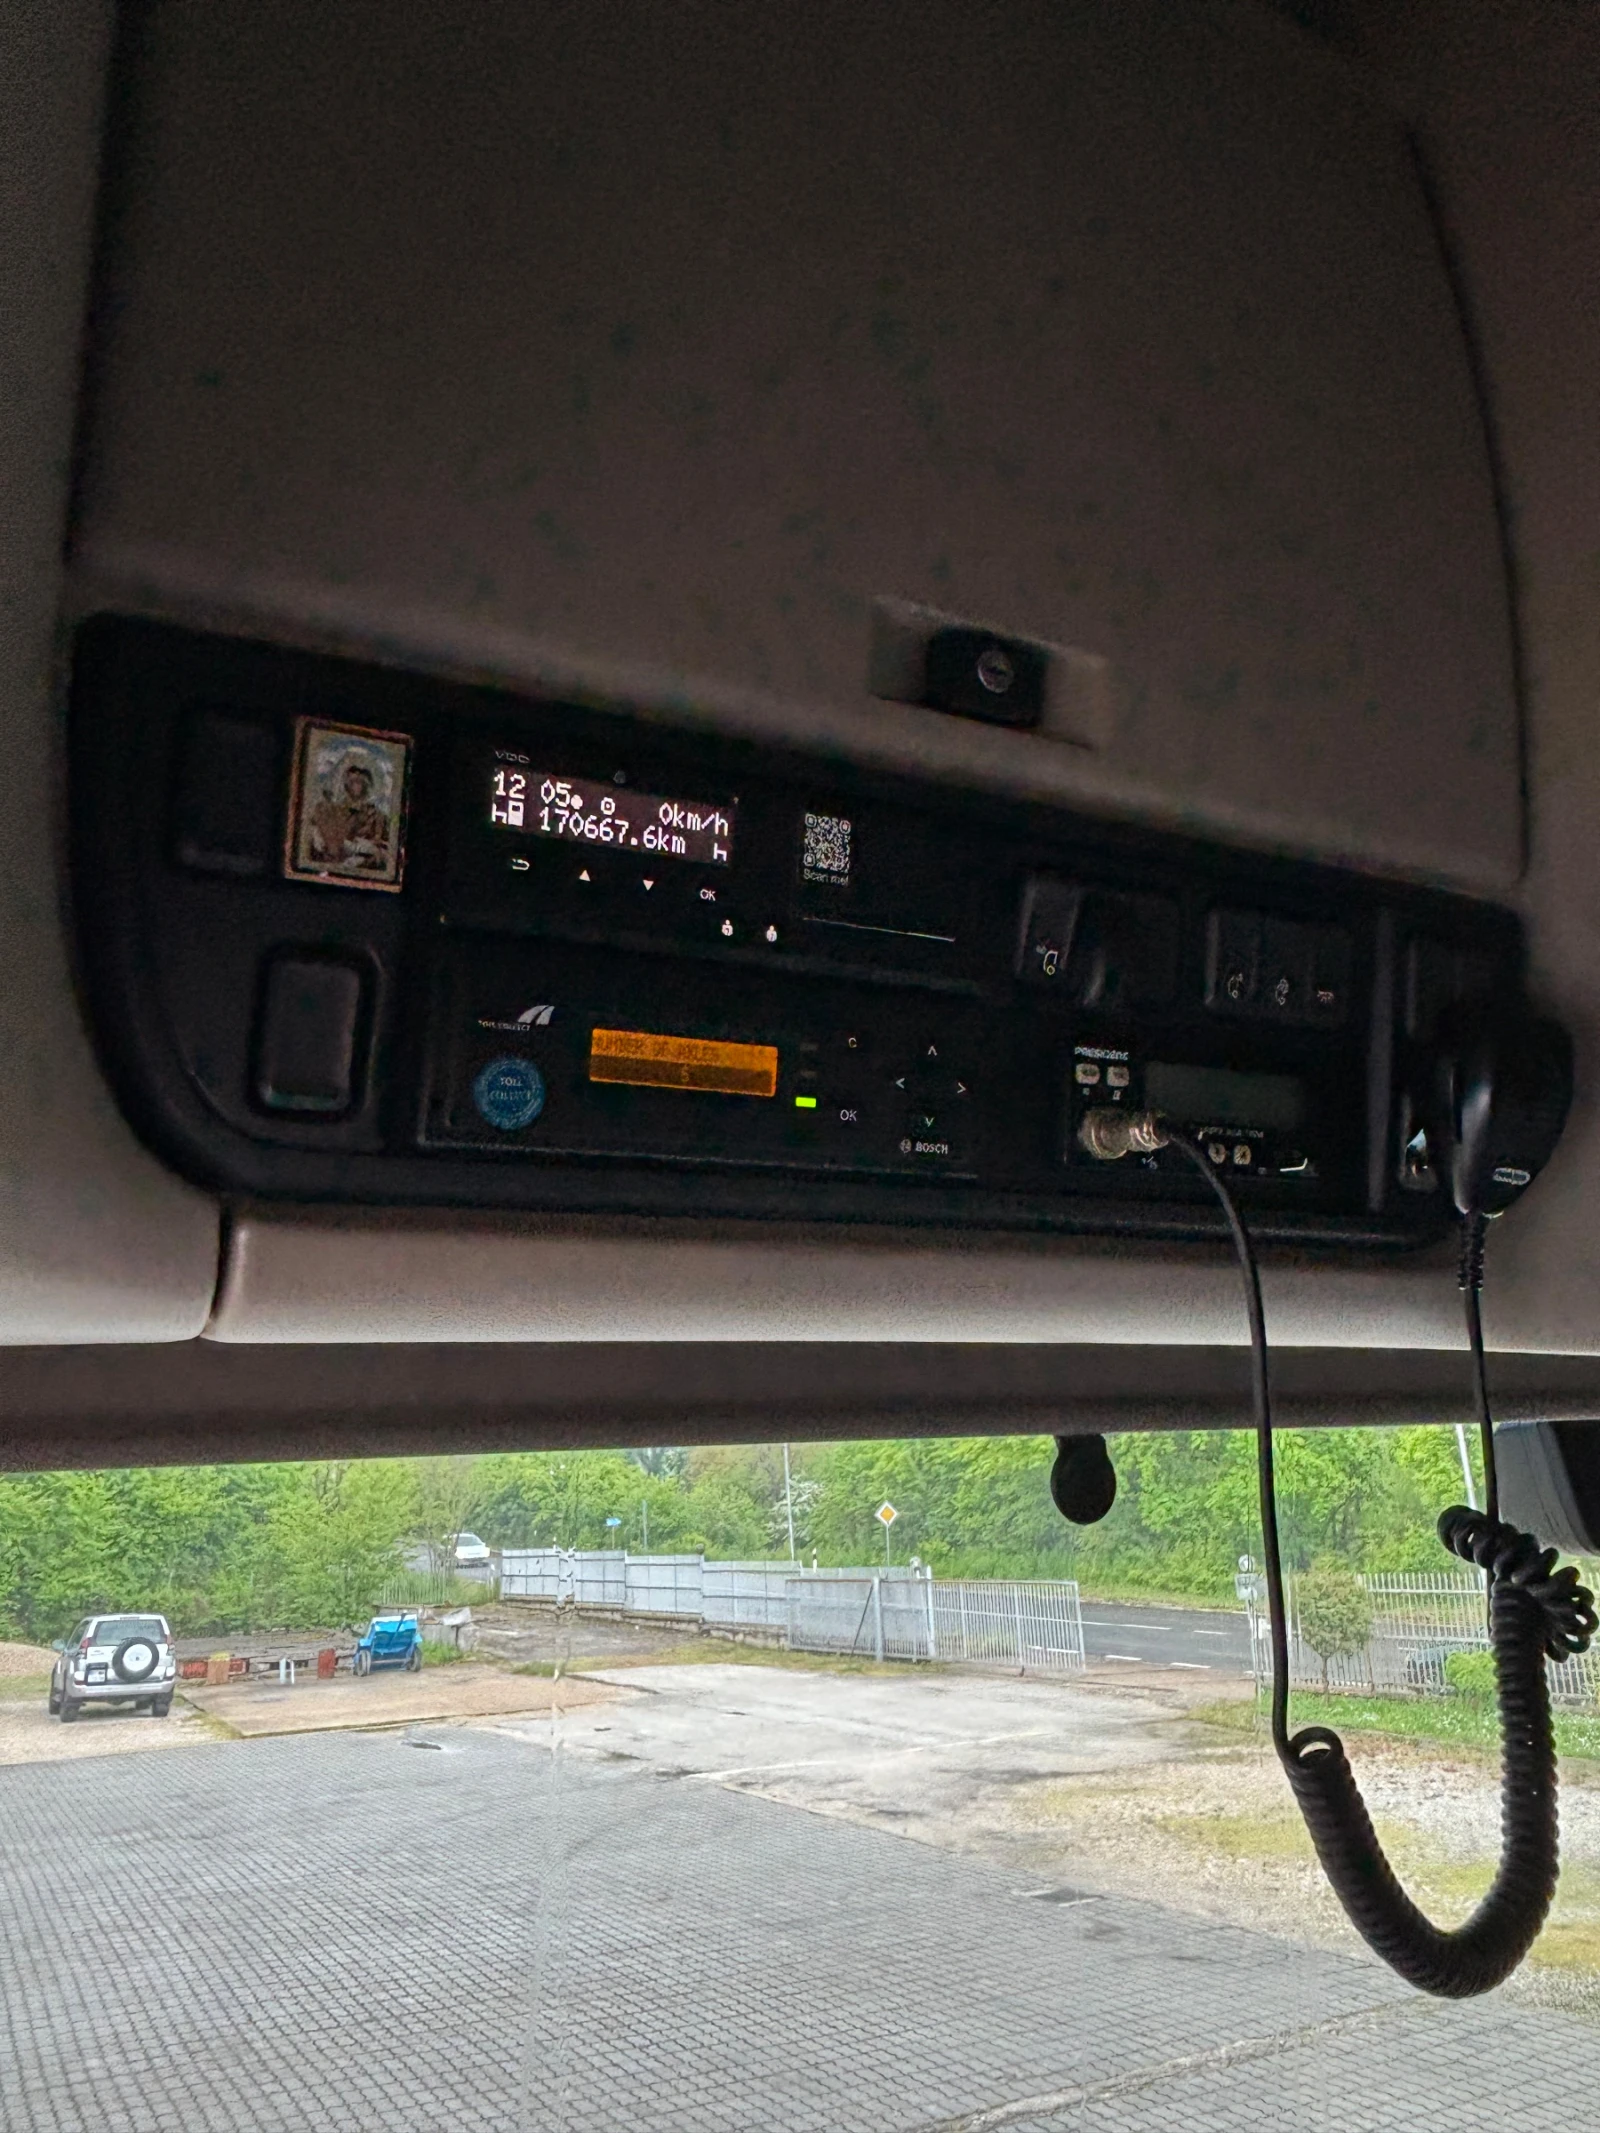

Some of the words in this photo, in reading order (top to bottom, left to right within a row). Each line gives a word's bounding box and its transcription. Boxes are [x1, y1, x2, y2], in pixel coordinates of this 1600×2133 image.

[493, 770, 526, 800] 12
[658, 802, 729, 837] 0km/h
[539, 806, 687, 854] 170667.6km
[700, 888, 716, 901] OK
[848, 1037, 857, 1048] C
[840, 1109, 857, 1122] OK
[915, 1140, 949, 1155] BOSCH
